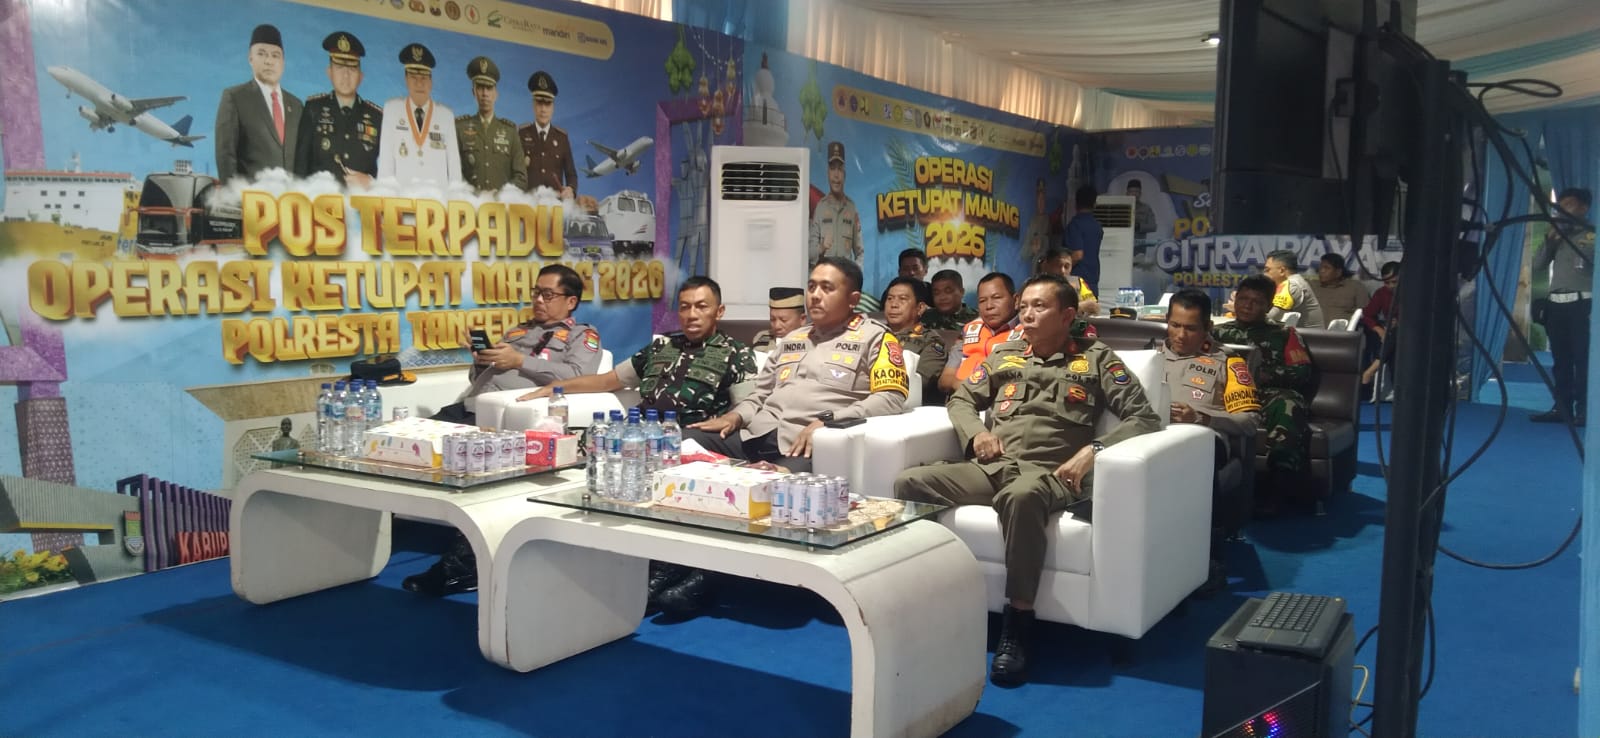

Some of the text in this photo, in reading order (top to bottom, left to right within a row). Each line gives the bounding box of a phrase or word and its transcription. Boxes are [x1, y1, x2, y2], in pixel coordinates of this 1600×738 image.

[915, 157, 993, 193] OPERASI
[243, 191, 564, 257] POS TERPADU
[877, 189, 1020, 229] KETUPAT MAUNG
[925, 222, 985, 258] 2026
[1174, 216, 1210, 240] PO
[1157, 235, 1265, 270] CITRA
[28, 259, 665, 320] OPERASI KETUPAT MAG 2026
[222, 312, 399, 364] POLRESTA
[783, 343, 806, 351] INDRA
[835, 342, 860, 351] POLRI
[1188, 363, 1217, 376] POLRI
[177, 531, 231, 565] KABUP
